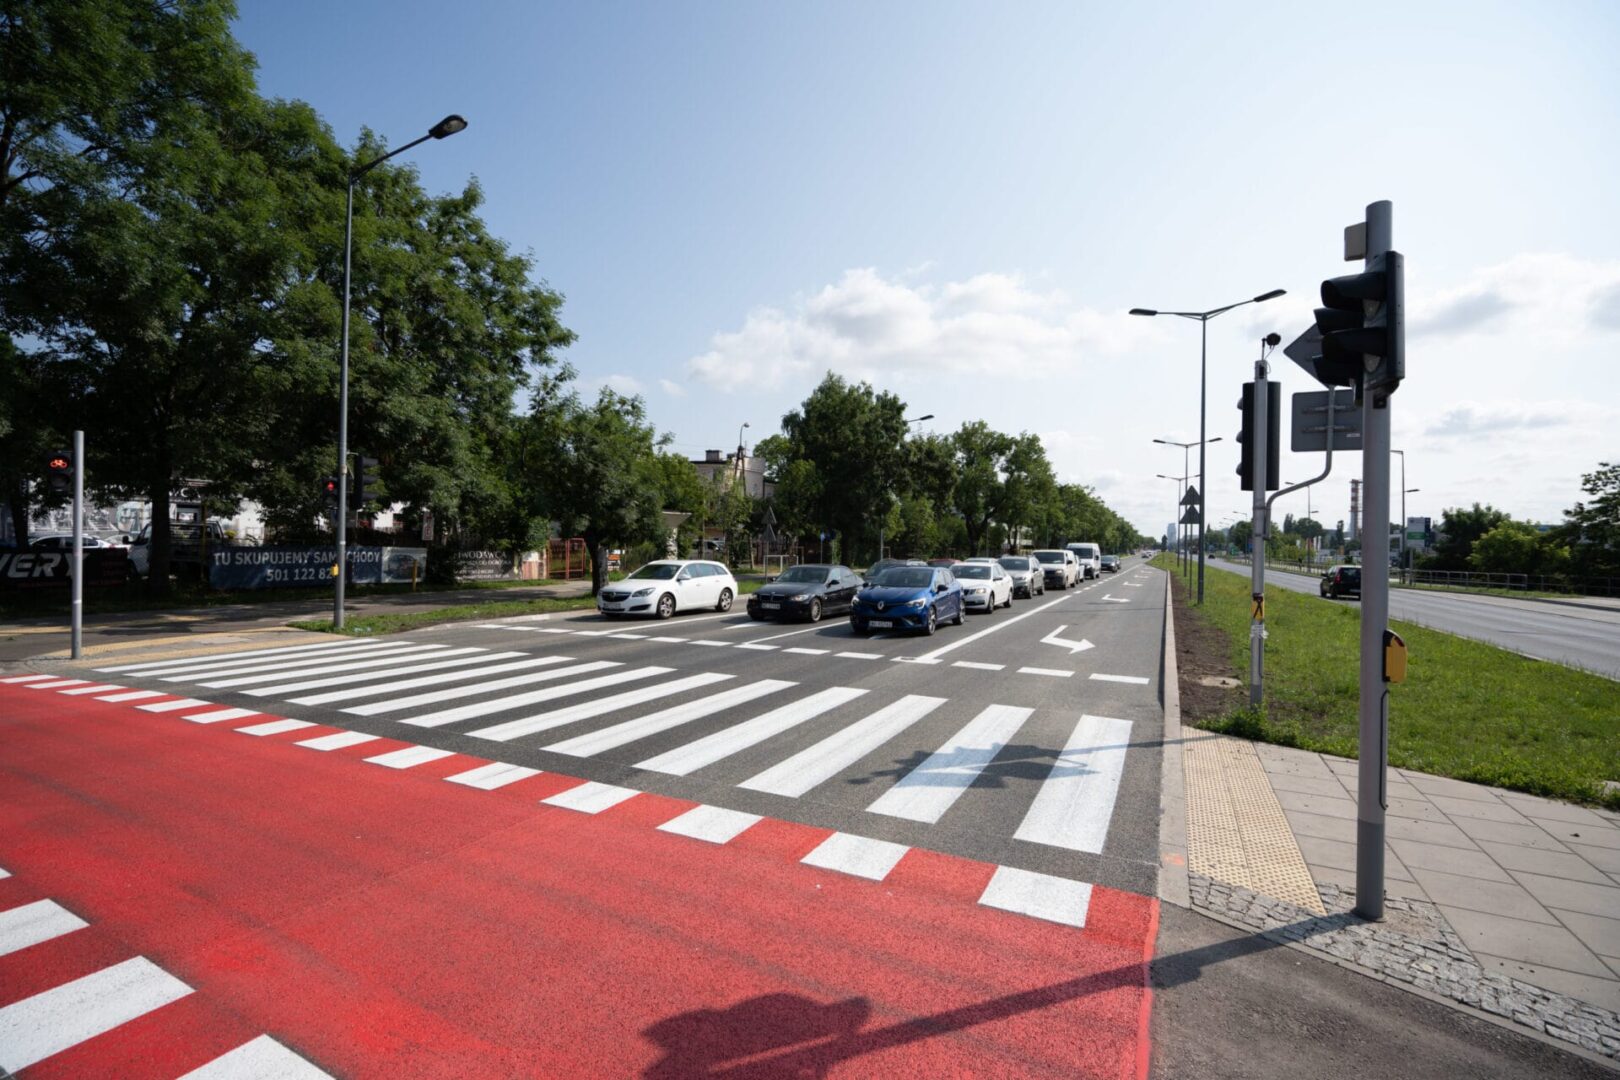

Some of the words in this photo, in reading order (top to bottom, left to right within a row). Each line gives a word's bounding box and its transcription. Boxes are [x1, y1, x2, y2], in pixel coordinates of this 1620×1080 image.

[213, 552, 231, 566] TU
[235, 551, 310, 565] SKUPUJEMY
[313, 550, 381, 564] SAMCHODY
[266, 568, 289, 582] 501
[293, 568, 316, 581] 122
